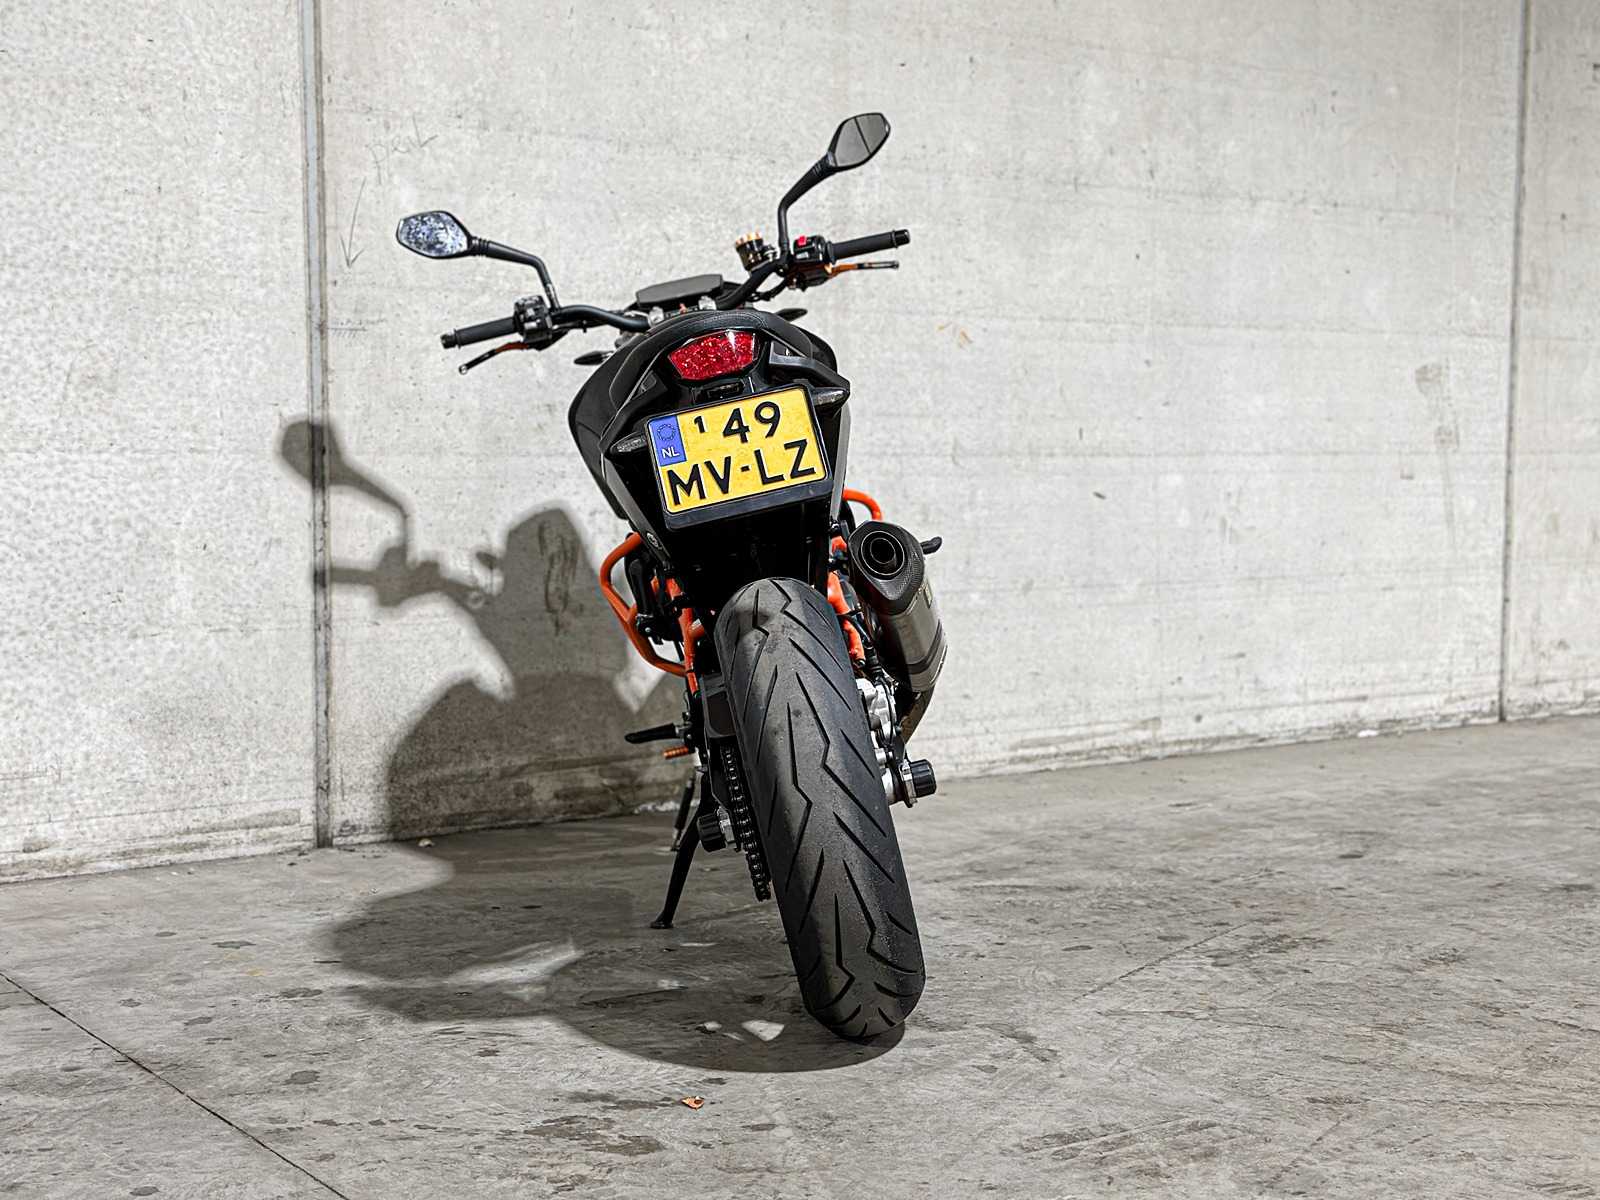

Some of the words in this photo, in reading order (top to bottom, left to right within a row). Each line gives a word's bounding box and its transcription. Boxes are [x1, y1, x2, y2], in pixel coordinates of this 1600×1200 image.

[694, 415, 706, 434] 1
[722, 401, 781, 443] 49
[661, 447, 679, 458] NL
[667, 438, 815, 505] MV-LZ
